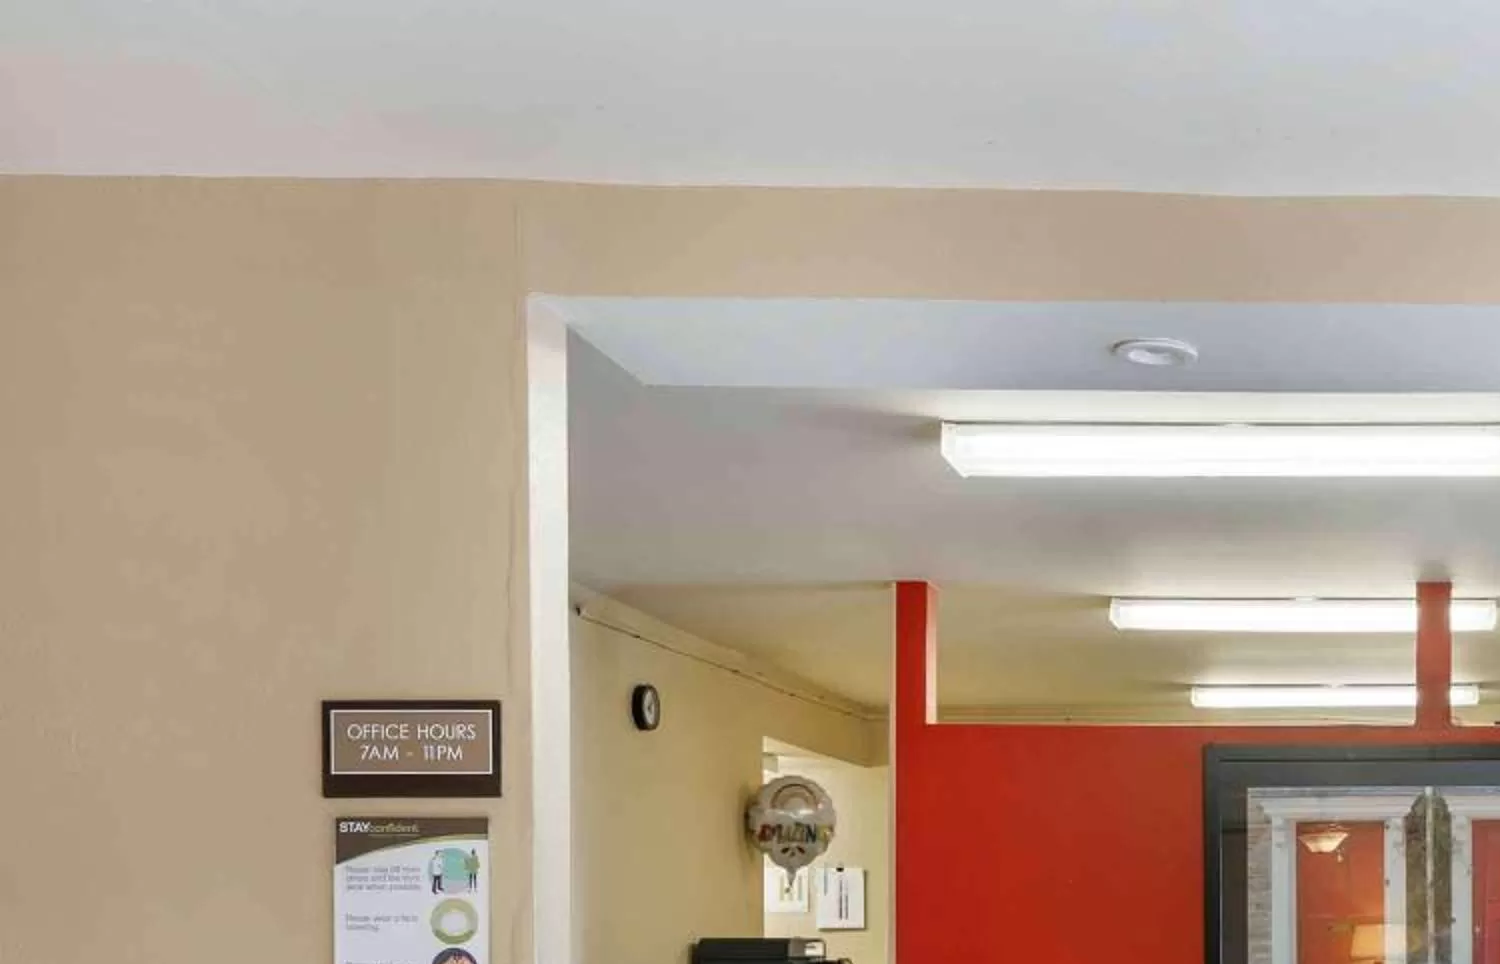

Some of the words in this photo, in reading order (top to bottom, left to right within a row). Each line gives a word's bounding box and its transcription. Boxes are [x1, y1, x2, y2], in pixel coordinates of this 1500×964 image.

[347, 724, 409, 740] OFFICE
[417, 724, 476, 740] HOURS
[360, 745, 399, 761] 7AM
[423, 745, 463, 761] 11PM
